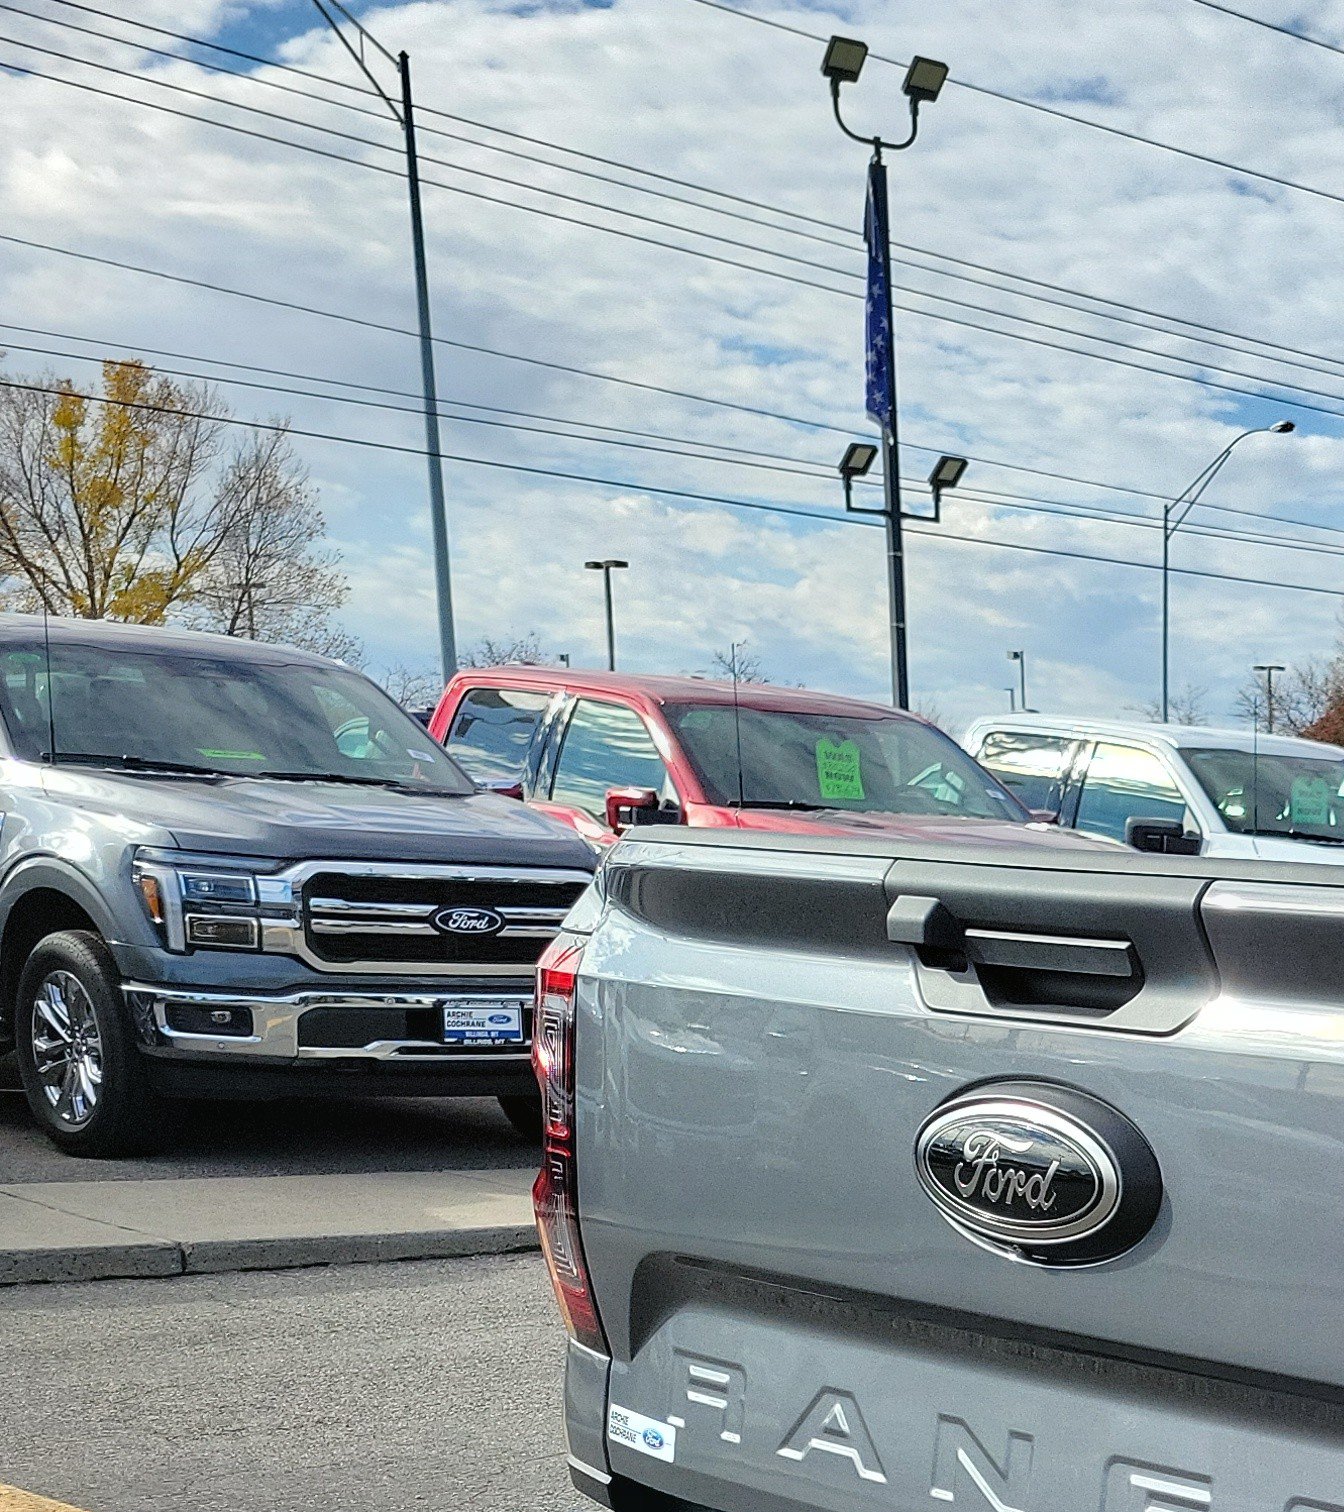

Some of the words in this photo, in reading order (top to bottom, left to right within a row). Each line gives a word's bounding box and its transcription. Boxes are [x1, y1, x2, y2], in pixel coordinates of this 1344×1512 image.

[448, 911, 490, 930] Ford
[446, 1020, 486, 1028] COCHRANE
[953, 1129, 1062, 1211] Ford
